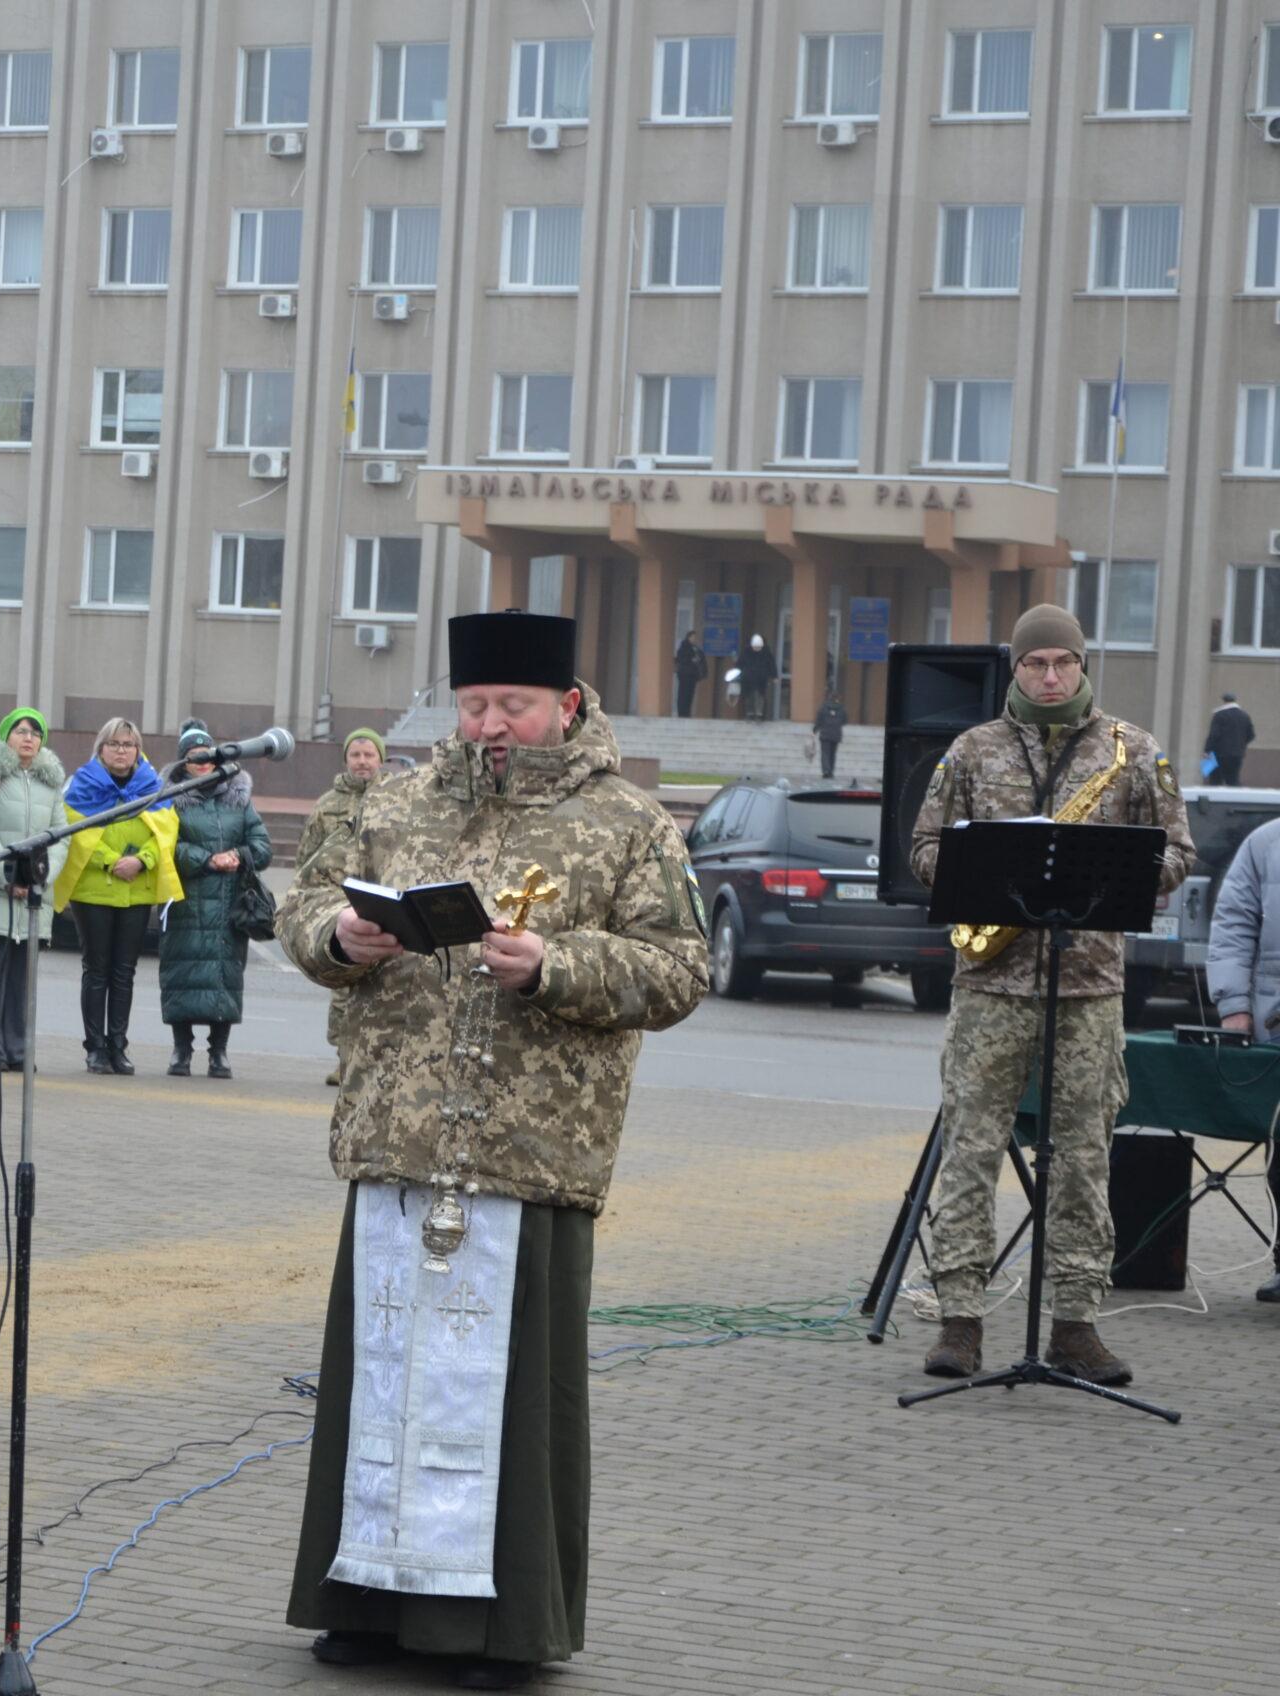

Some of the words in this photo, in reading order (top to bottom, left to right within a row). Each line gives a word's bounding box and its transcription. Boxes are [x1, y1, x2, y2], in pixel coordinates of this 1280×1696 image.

[445, 473, 681, 501] ІЗМАЇЛЬСЬКА
[709, 480, 846, 506] МІСЬКА
[876, 483, 972, 509] РАДА
